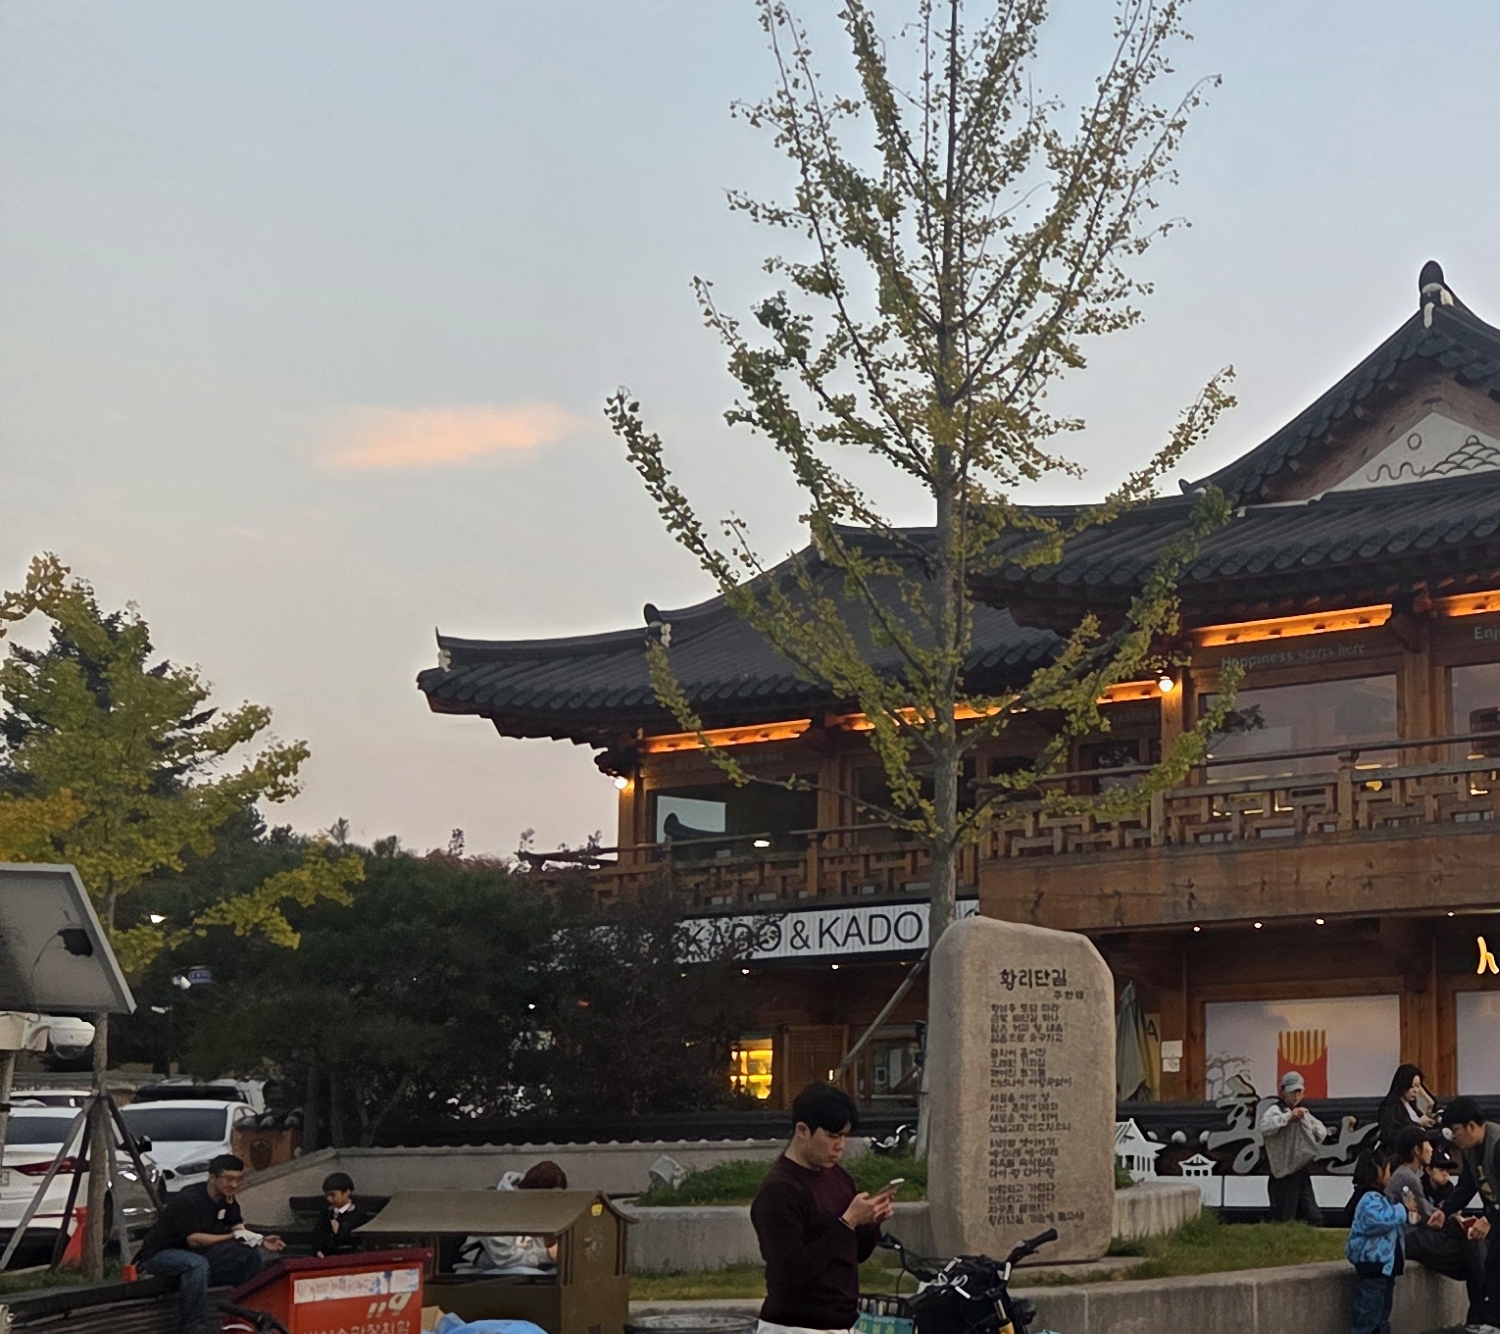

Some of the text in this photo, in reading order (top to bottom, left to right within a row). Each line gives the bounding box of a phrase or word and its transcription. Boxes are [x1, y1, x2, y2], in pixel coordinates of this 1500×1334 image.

[789, 919, 810, 951] &
[818, 910, 923, 948] KADO
[999, 968, 1068, 991] 황리단길
